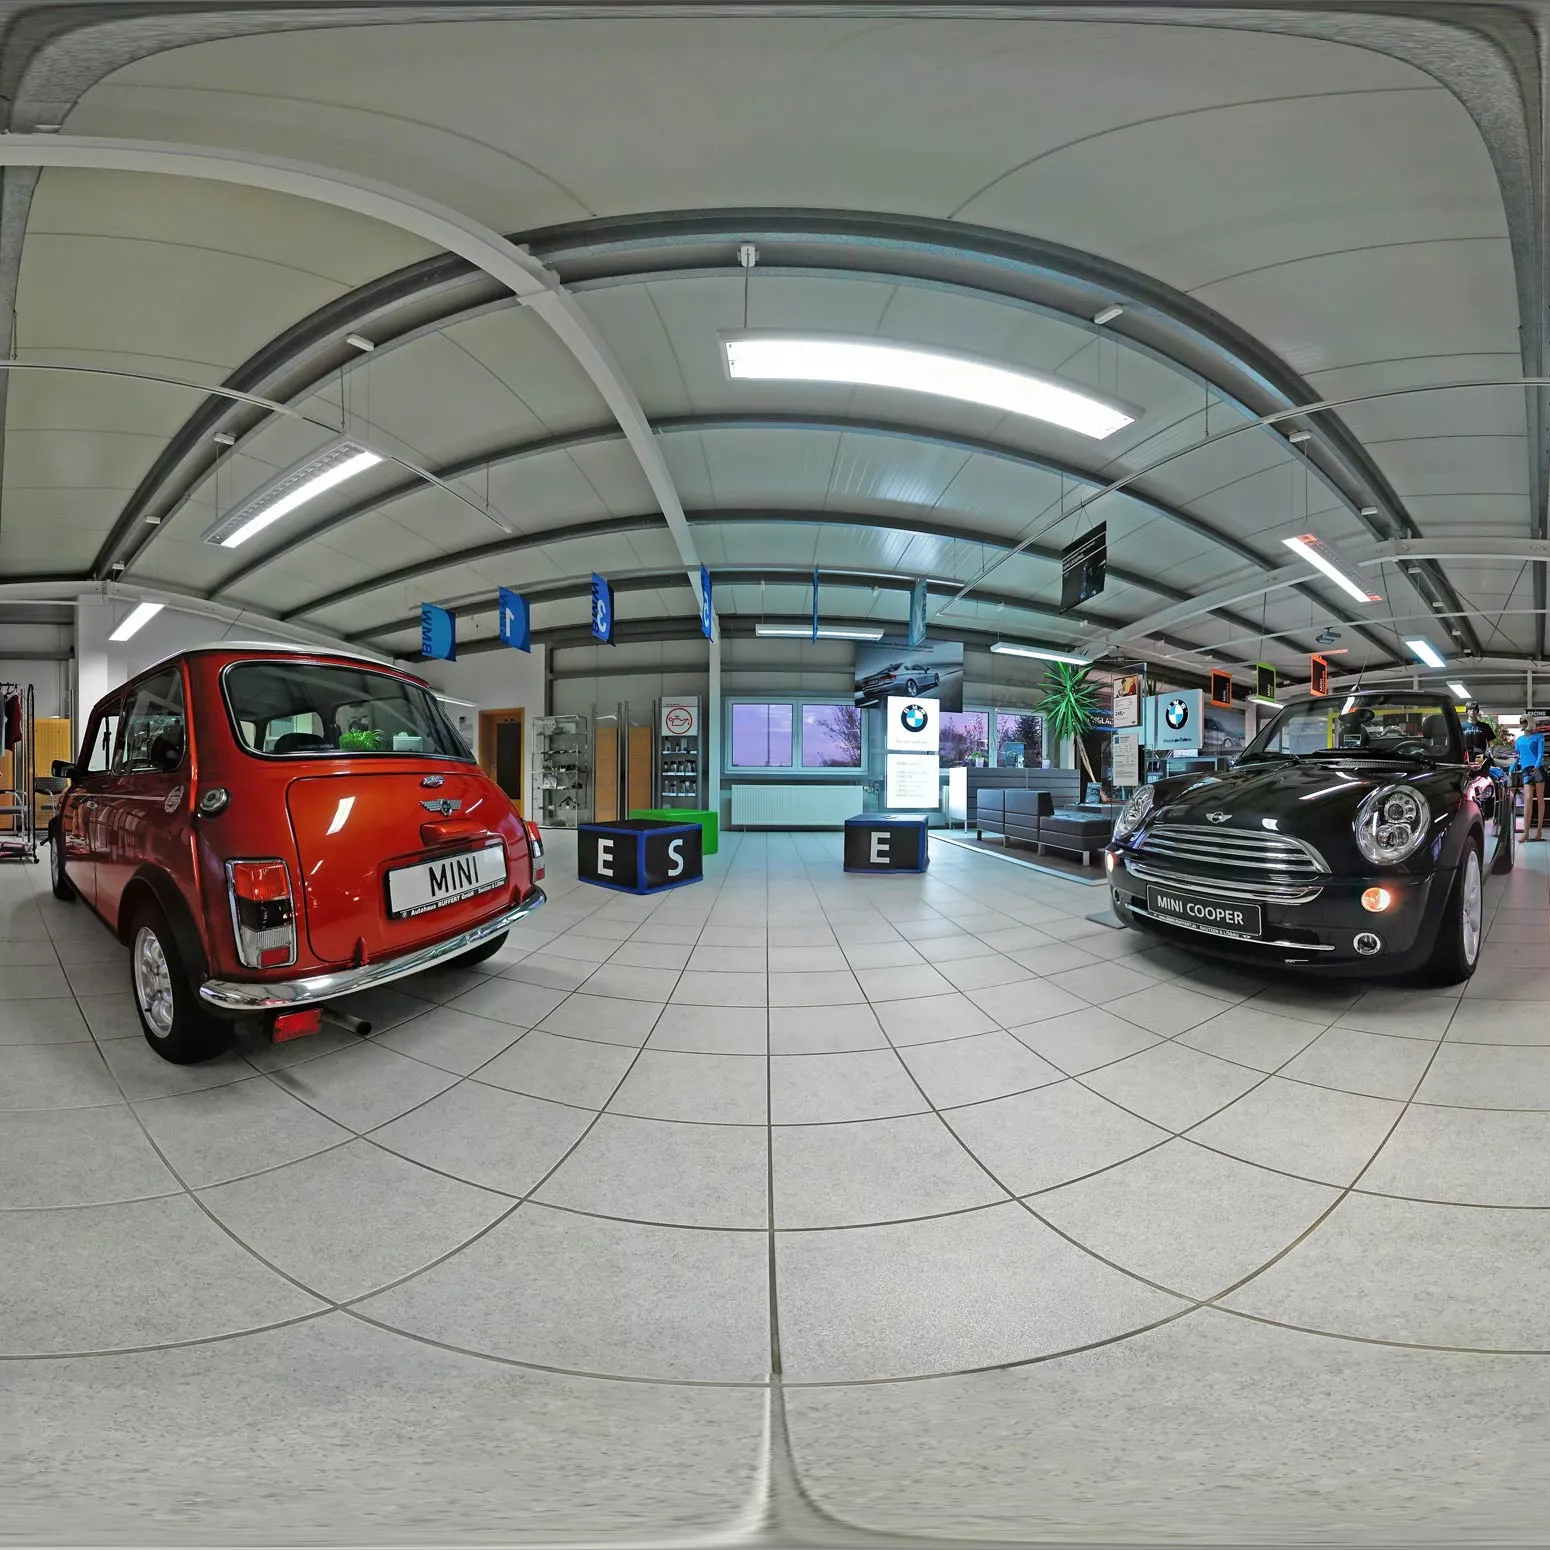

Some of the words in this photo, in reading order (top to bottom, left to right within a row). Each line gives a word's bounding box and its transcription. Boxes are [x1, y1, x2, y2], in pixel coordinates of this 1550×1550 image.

[597, 838, 614, 876] E
[667, 838, 684, 876] S
[869, 831, 891, 864] E
[428, 855, 479, 897] MINI
[410, 903, 437, 917] Autohaus
[1157, 895, 1183, 913] MINI
[1186, 903, 1244, 925] COOPER
